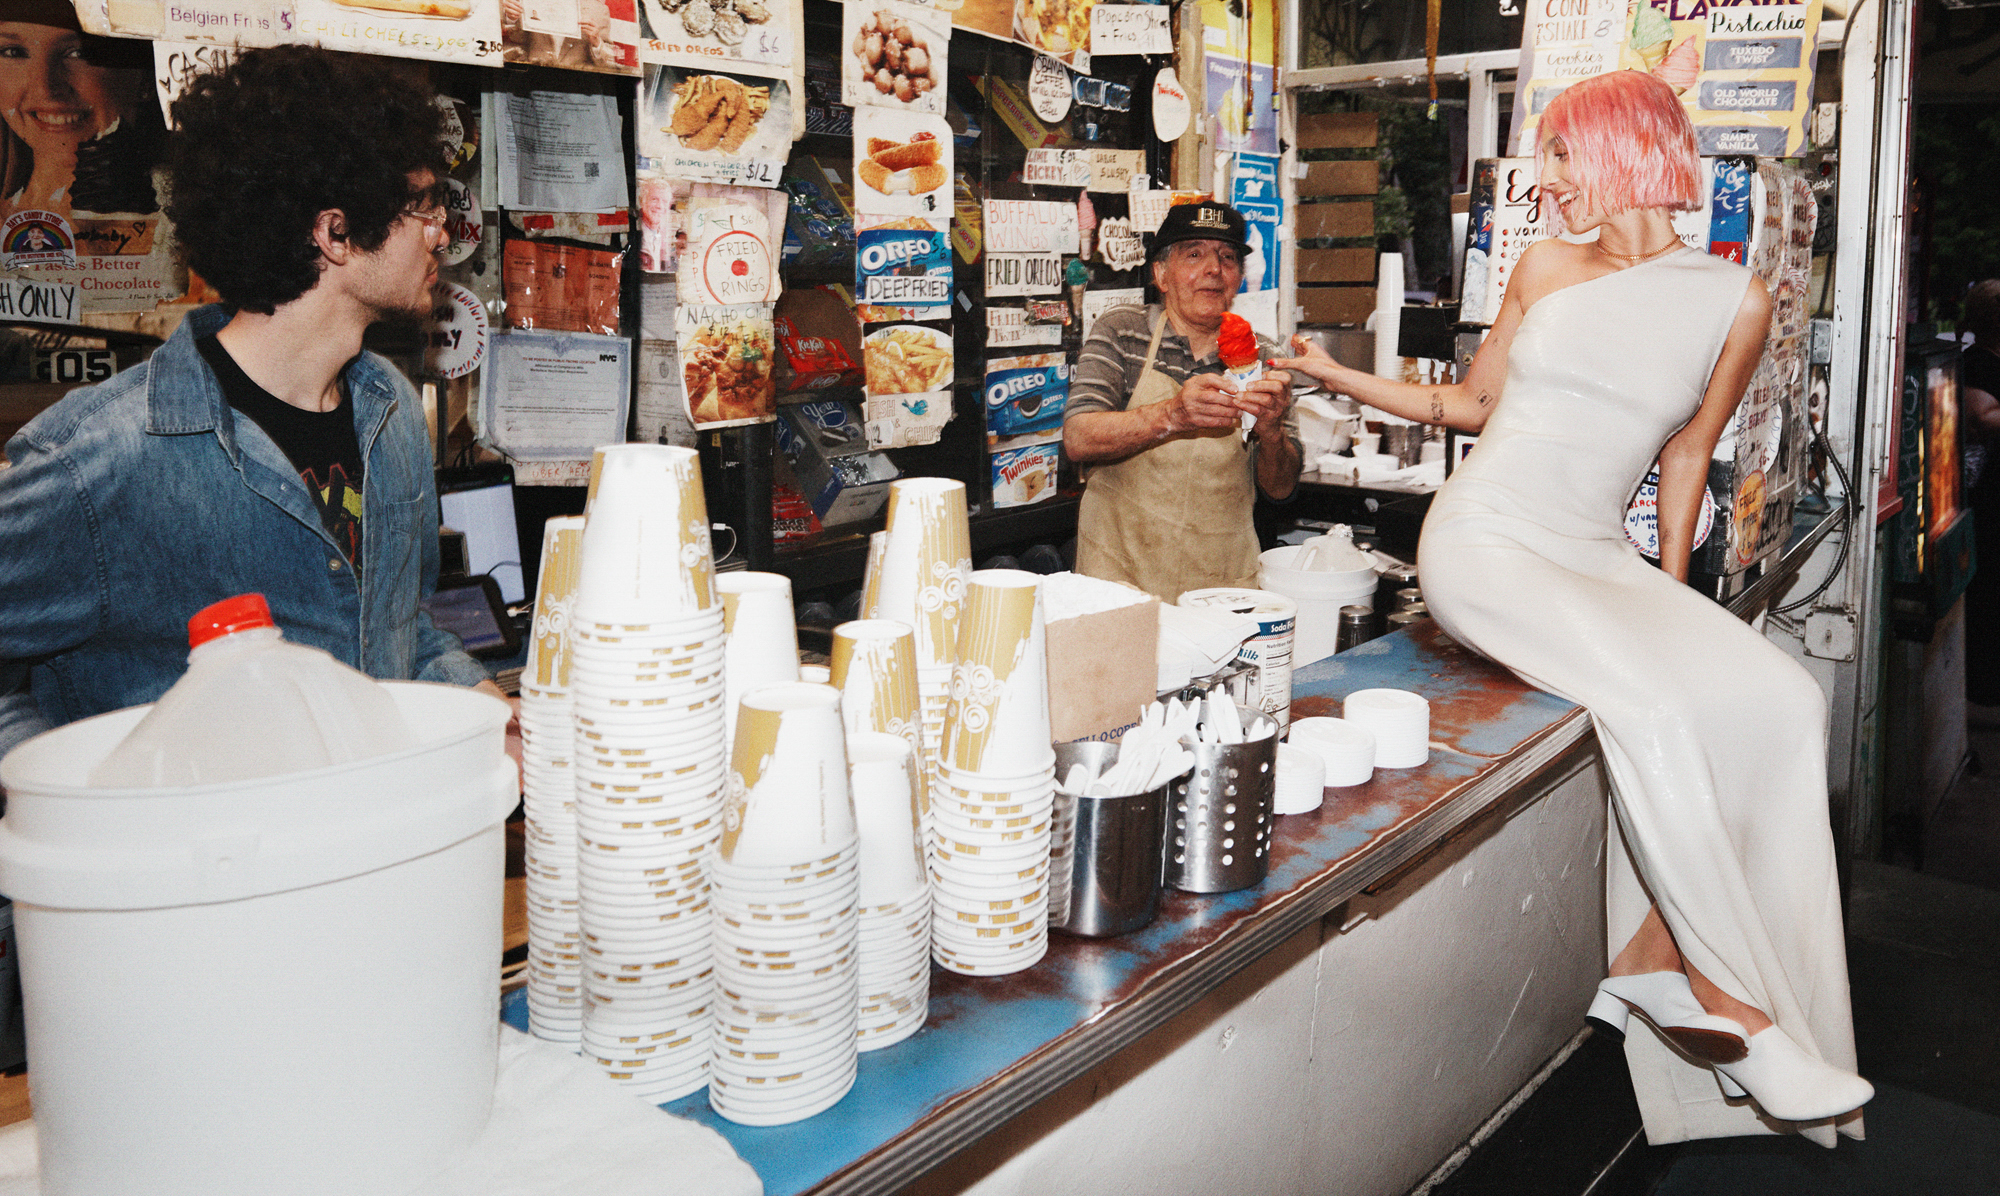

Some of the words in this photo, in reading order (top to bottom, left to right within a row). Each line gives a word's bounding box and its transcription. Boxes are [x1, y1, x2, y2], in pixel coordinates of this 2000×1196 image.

[171, 7, 228, 27] Belgian
[234, 13, 270, 29] Frs
[1711, 11, 1806, 34] Pistachio
[649, 39, 681, 53] FRIED
[685, 44, 724, 56] OREOS
[1729, 46, 1776, 56] TUXEDO
[1034, 57, 1064, 76] OBAMA
[1735, 55, 1768, 64] TWIST
[991, 79, 1026, 122] ASPBERRY
[1713, 88, 1736, 98] OLD
[1739, 88, 1779, 98] WORLD
[1713, 97, 1778, 107] CHOCOLATE
[1716, 141, 1760, 150] VANILLA
[1720, 133, 1758, 142] SIMPLY
[1027, 150, 1048, 163] LIME
[1026, 163, 1063, 181] RICKEY
[990, 200, 1058, 225] BUFFALO
[989, 226, 1049, 250] WINGS
[717, 241, 759, 257] FRIED
[861, 239, 931, 271] OREO
[92, 257, 141, 271] Better
[926, 265, 953, 277] OREO
[988, 258, 1021, 286] FRIED
[1025, 258, 1061, 287] OREOS
[80, 276, 162, 291] Chocolate
[721, 276, 766, 298] RINGS
[18, 285, 75, 321] ONLY
[686, 306, 739, 326] NACHO
[1033, 304, 1060, 320] TWIX
[599, 353, 617, 363] NYC
[988, 373, 1046, 405] OREO
[1042, 393, 1064, 407] OREO
[532, 468, 560, 479] UBER
[1000, 453, 1045, 485] Twinkies
[1271, 623, 1287, 633] Soda
